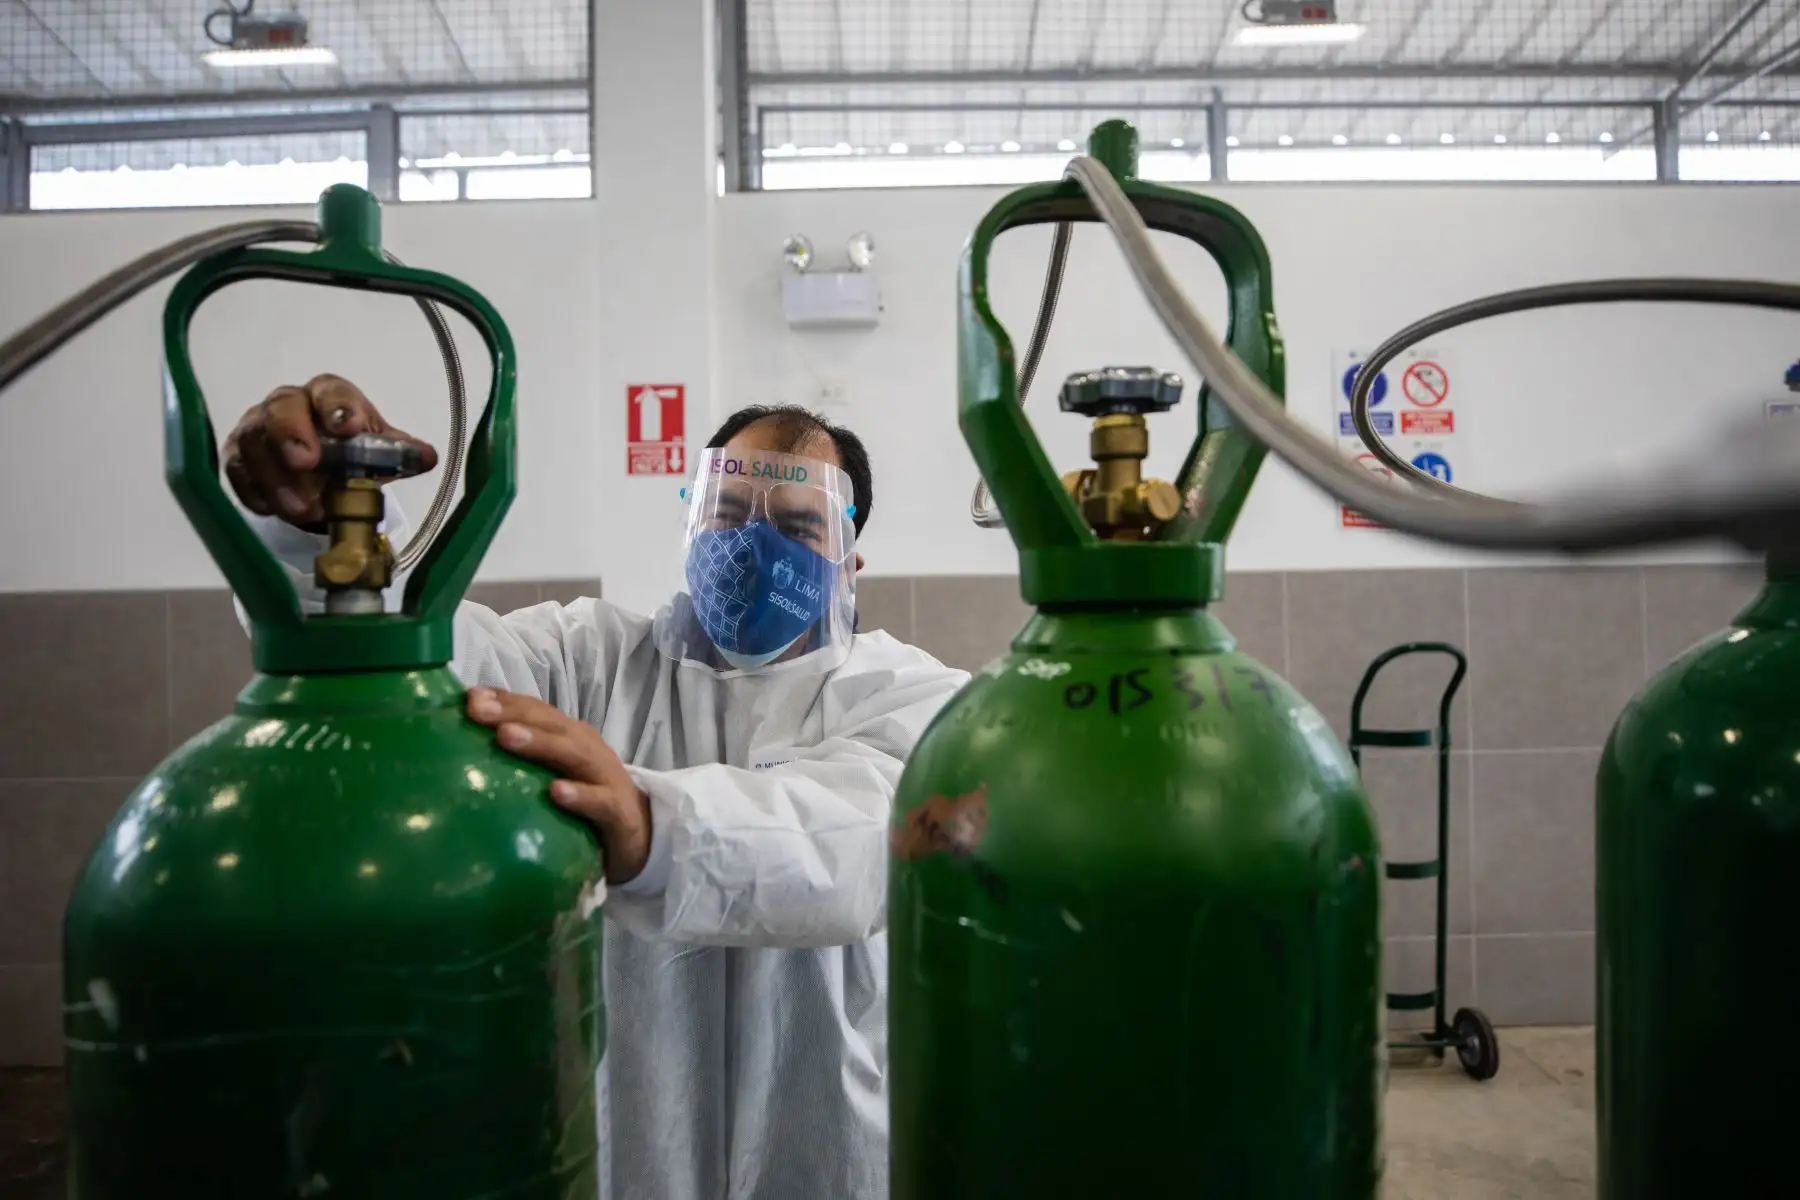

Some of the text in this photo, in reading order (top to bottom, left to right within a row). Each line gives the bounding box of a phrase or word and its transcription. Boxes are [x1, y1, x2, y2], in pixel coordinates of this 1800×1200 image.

[710, 458, 808, 482] ISOL SALUD
[794, 579, 820, 604] LIMA
